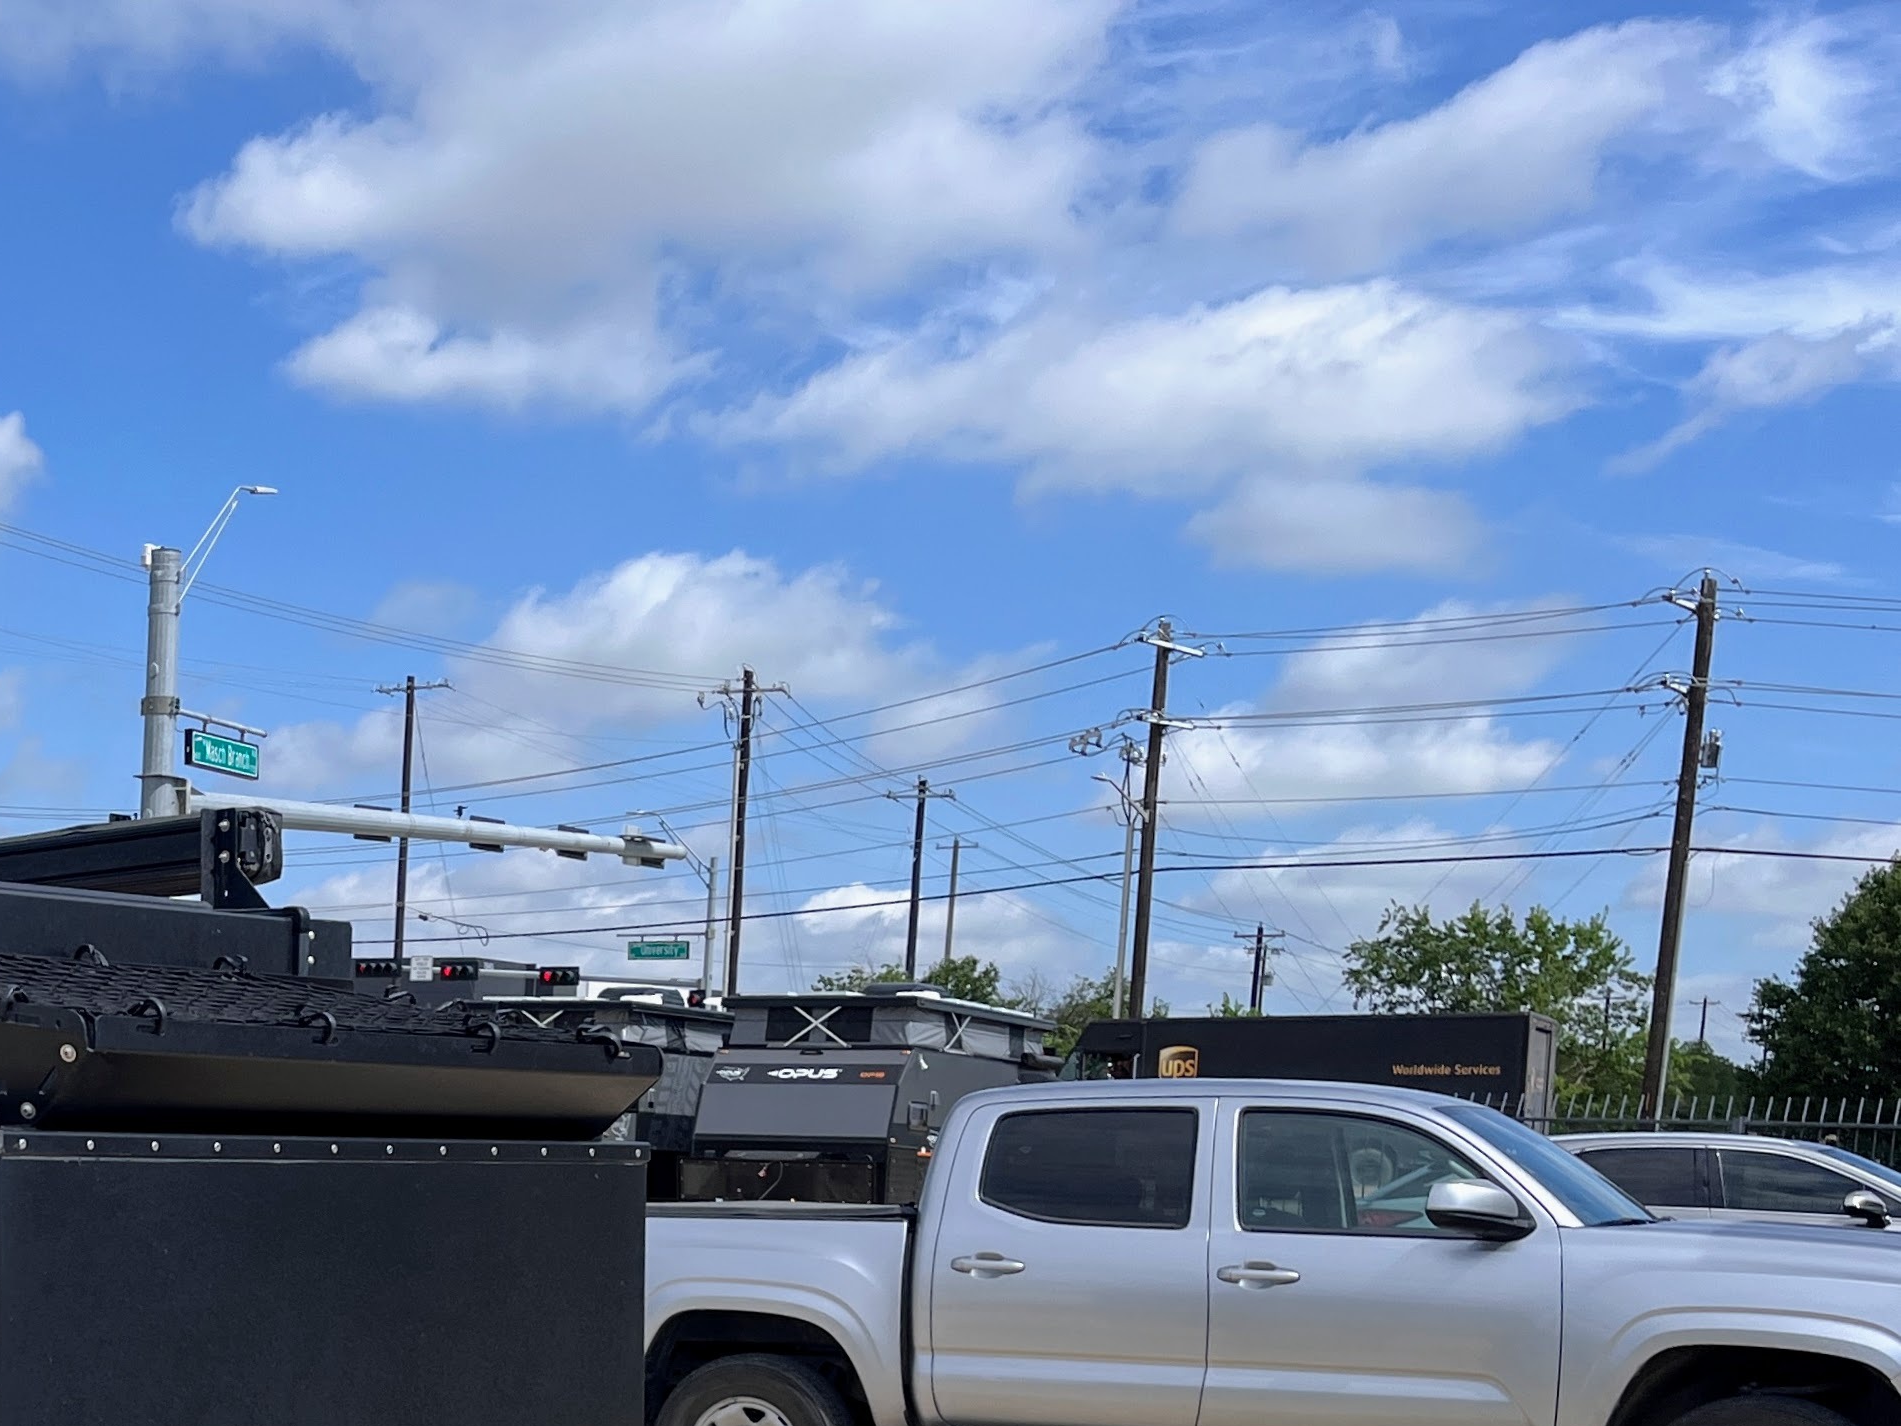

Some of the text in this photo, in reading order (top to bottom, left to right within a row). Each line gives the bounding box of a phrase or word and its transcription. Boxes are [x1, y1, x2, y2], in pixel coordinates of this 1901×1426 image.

[640, 945, 679, 957] University
[778, 1068, 839, 1079] OPUS
[1392, 1063, 1501, 1076] Worldwide Services
